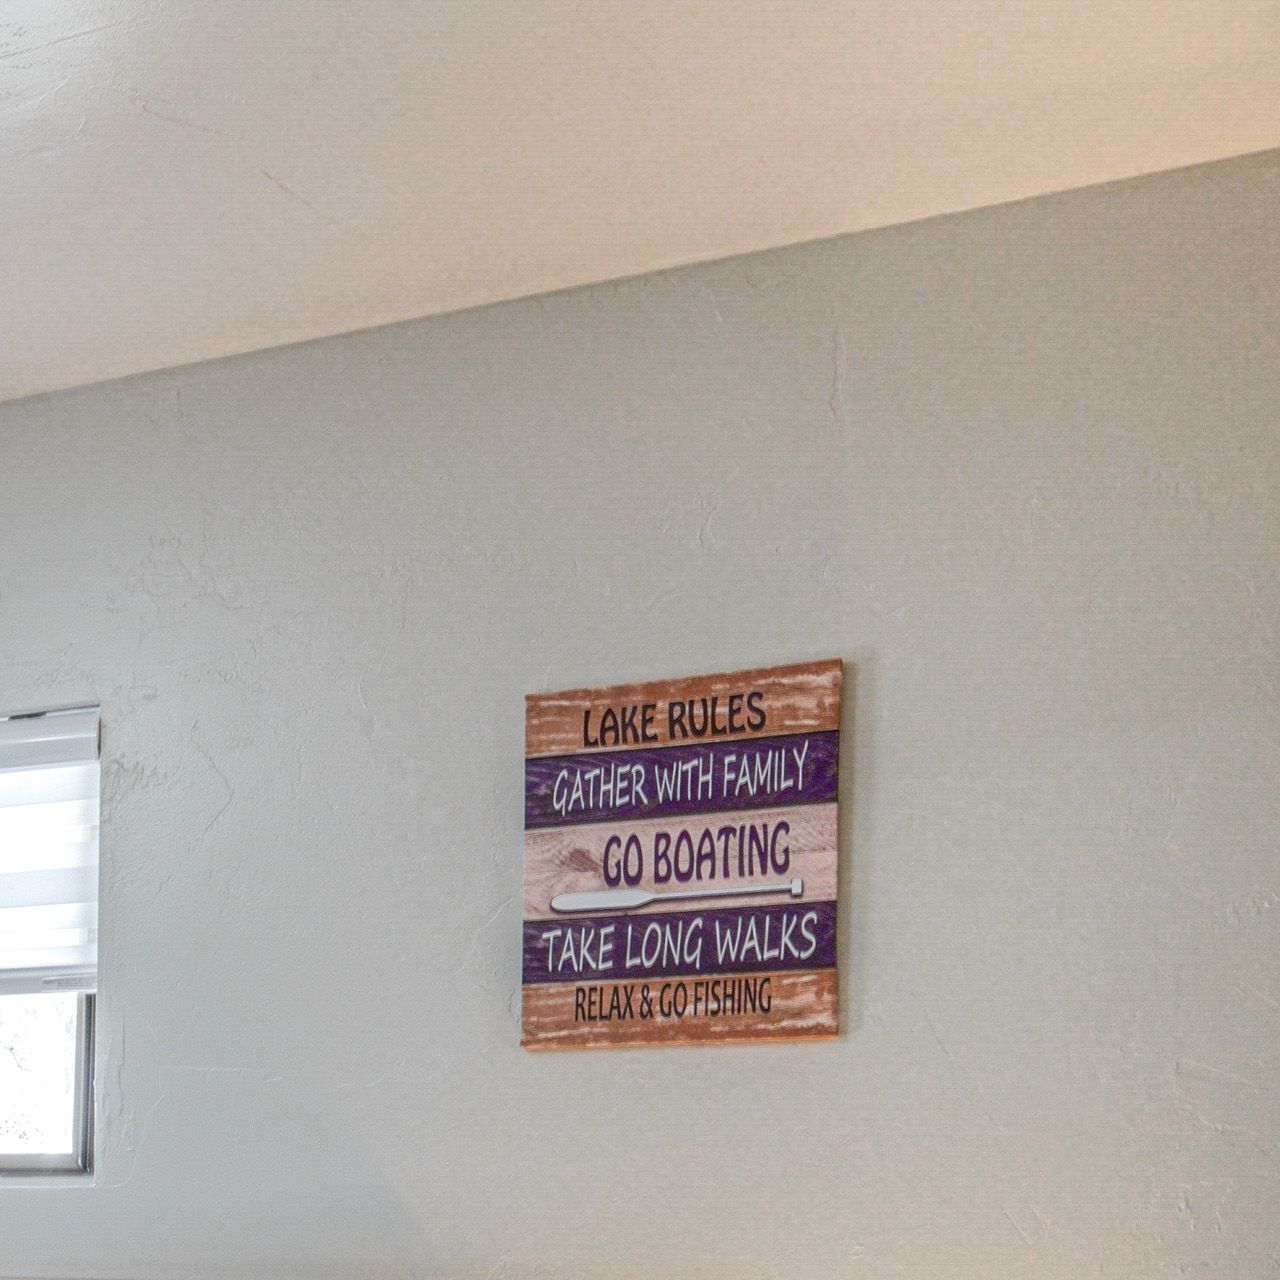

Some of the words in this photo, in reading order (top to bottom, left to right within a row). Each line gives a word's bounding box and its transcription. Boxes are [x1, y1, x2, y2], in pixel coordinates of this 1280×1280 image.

[583, 704, 658, 748] LAKE
[668, 691, 766, 741] RULES
[552, 763, 648, 816] GATHER
[654, 754, 714, 803] WITH
[723, 739, 809, 796] FAMILY
[602, 834, 644, 887] GO
[654, 820, 790, 883] BOATING
[542, 925, 616, 972] TAKE
[625, 917, 704, 969] LONG
[715, 911, 818, 964] WALKS
[575, 985, 635, 1022] RELAX
[639, 987, 653, 1017] &
[659, 982, 687, 1016] GO
[693, 978, 772, 1016] FISHING
